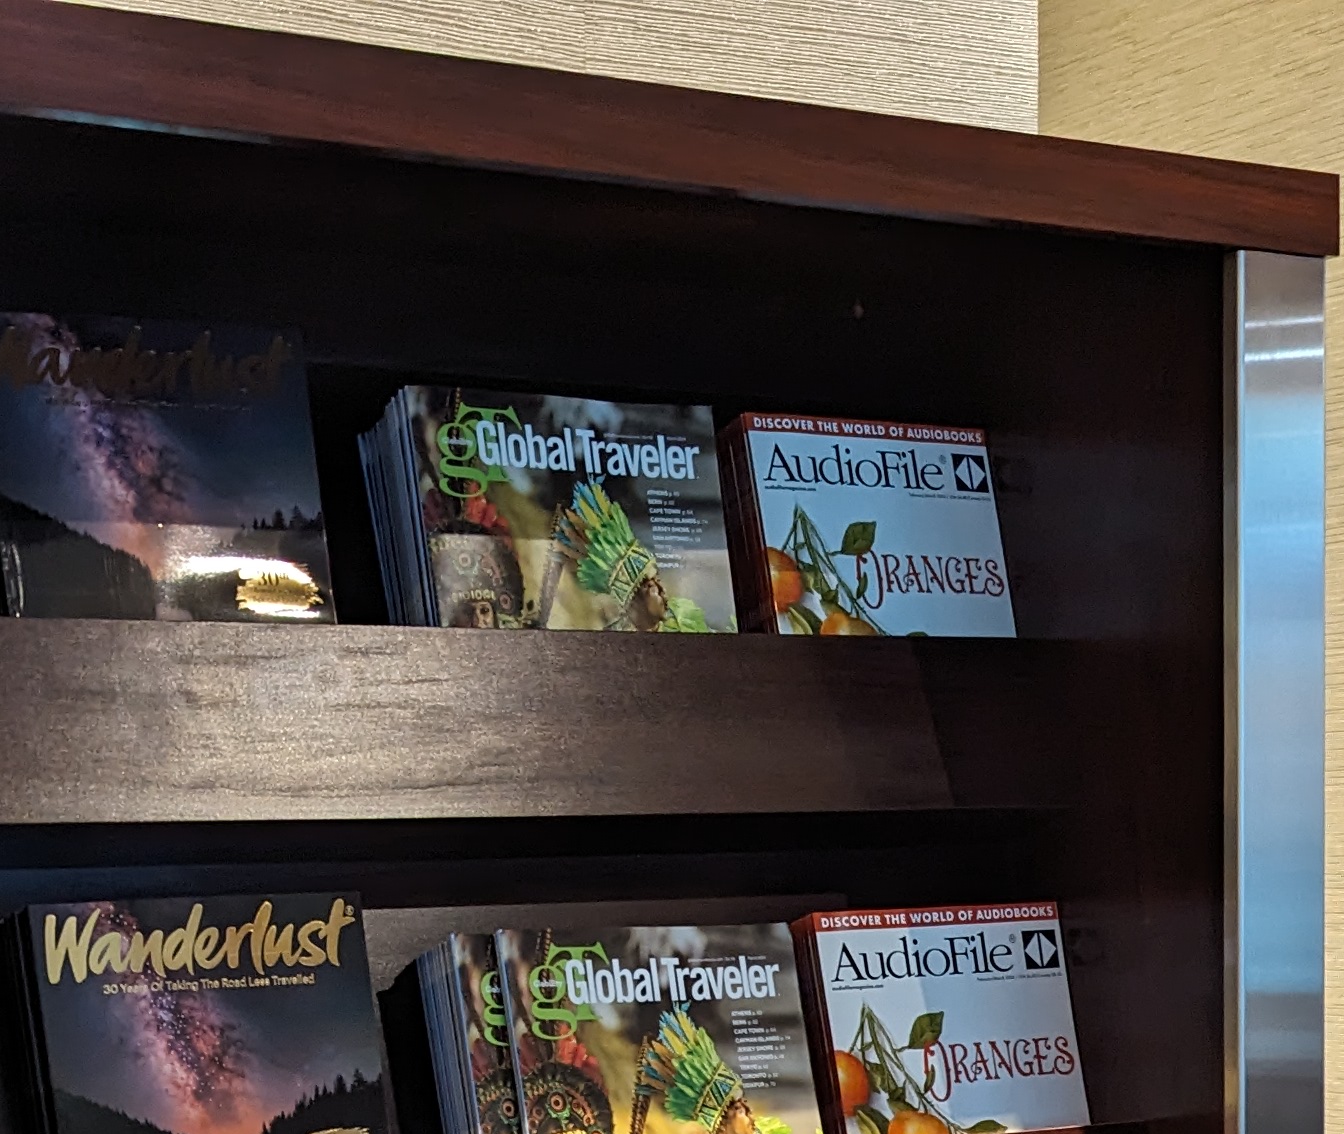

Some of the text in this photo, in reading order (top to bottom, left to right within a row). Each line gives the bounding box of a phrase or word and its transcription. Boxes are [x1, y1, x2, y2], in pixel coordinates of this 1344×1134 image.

[474, 419, 701, 480] Global Traveler
[753, 417, 982, 443] DISCOVER THE WORLD OF AUDIOBOOKS
[763, 443, 944, 491] AudioFile
[856, 550, 1005, 609] ORANGES
[42, 897, 356, 985] Wanderlust
[820, 906, 1054, 928] DISCOVER THE WORLD OF AUDIOBOOKS
[564, 955, 780, 1005] Global Traveler
[831, 930, 1015, 982] AudioFile
[102, 984, 119, 995] 30
[166, 979, 199, 993] Taking
[201, 978, 220, 989] The
[221, 976, 247, 988] Road
[248, 975, 270, 987] Less
[272, 972, 316, 986] Travelled
[923, 1036, 1076, 1102] ORANGES
